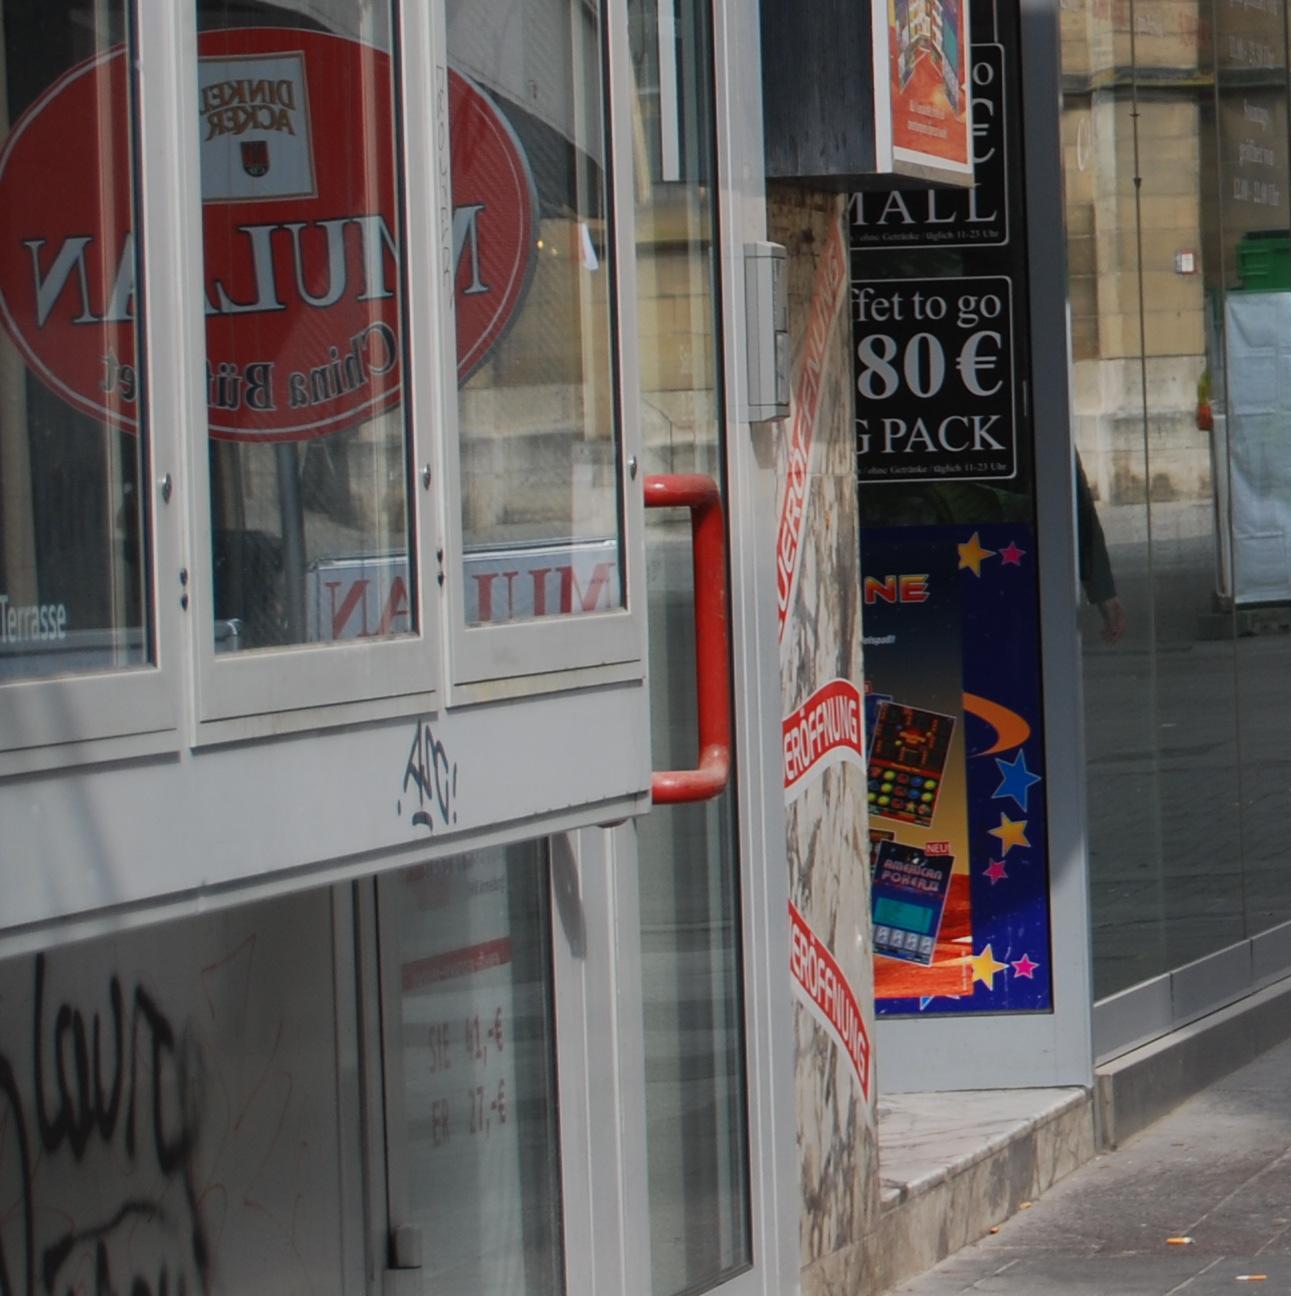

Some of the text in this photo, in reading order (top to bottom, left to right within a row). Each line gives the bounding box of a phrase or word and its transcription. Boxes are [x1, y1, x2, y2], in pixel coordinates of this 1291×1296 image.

[912, 291, 947, 320] to
[957, 294, 1001, 328] go
[881, 415, 1006, 454] PACK
